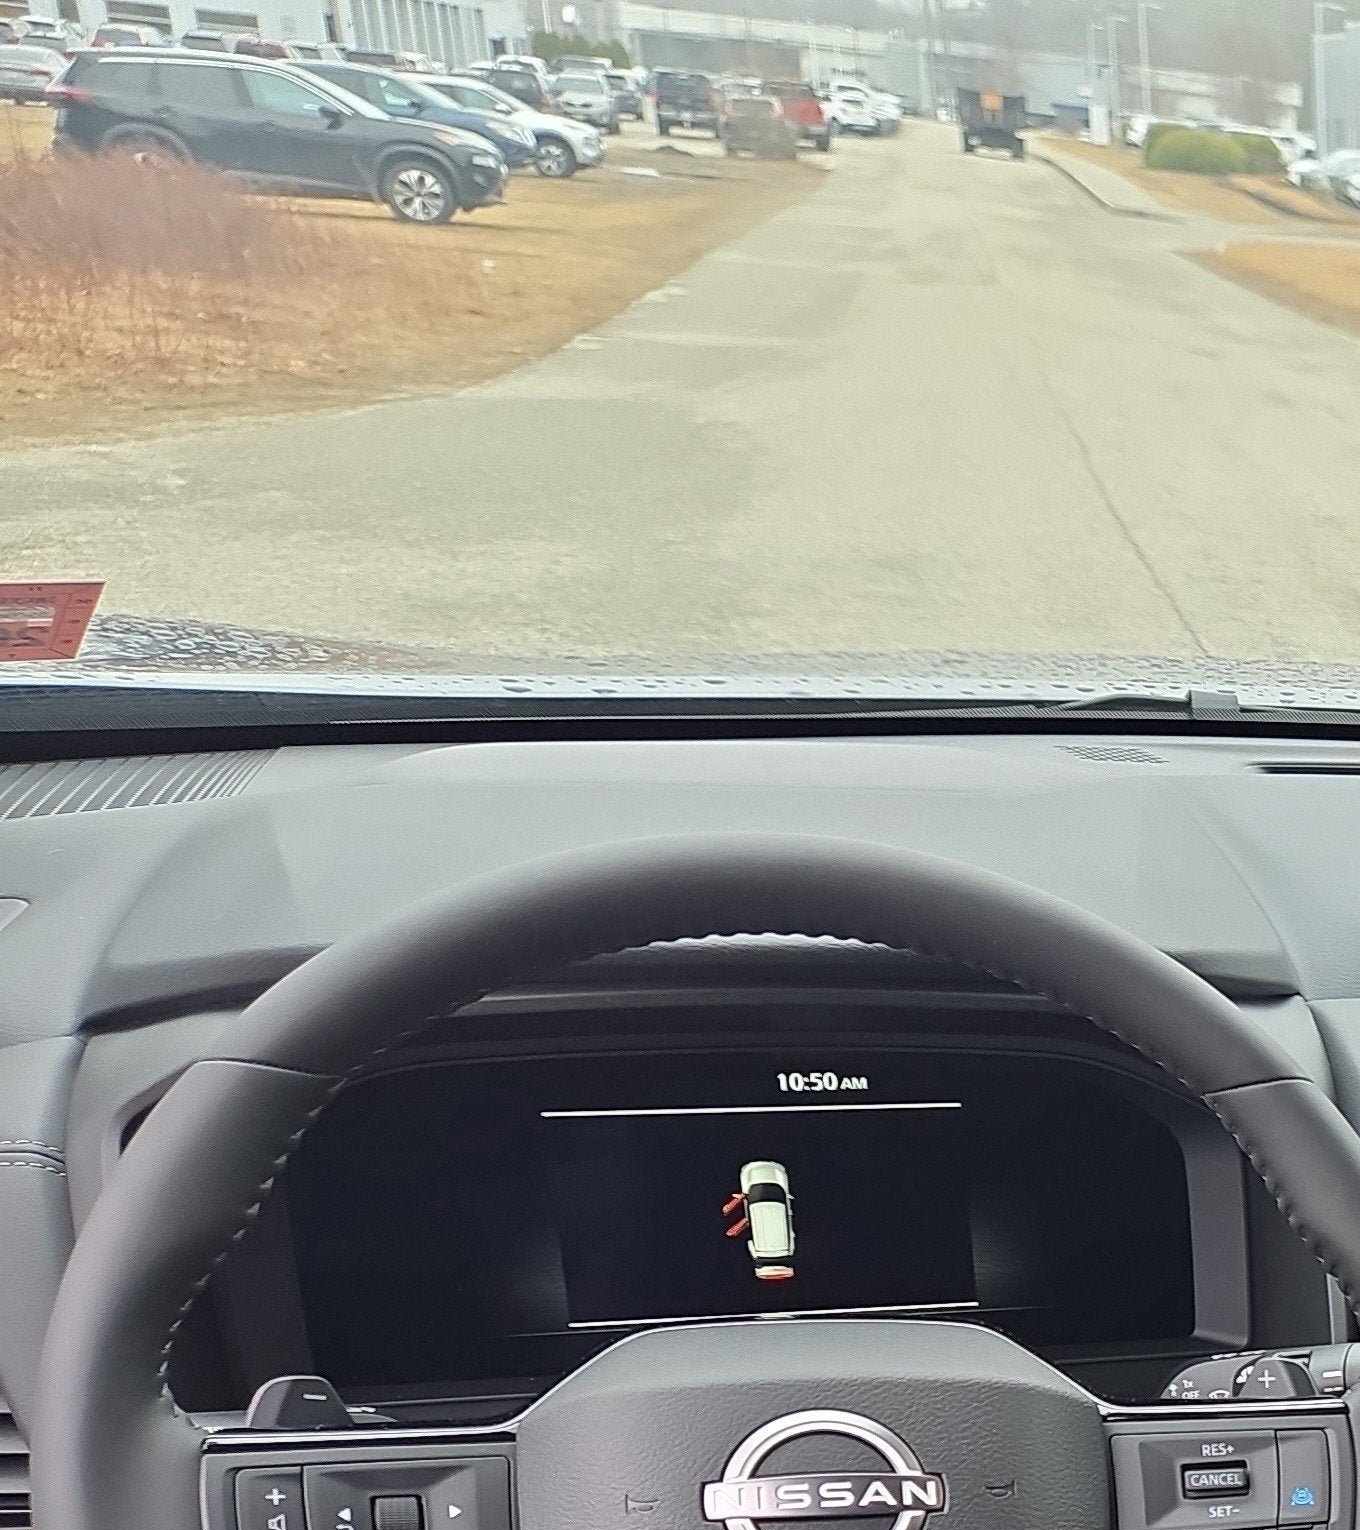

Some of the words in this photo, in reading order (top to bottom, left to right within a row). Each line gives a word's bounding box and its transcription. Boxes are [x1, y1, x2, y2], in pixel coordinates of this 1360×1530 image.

[776, 1072, 839, 1092] 10:50
[840, 1076, 868, 1091] AM
[1201, 1443, 1235, 1456] RES+
[1189, 1473, 1242, 1487] CANCEL
[712, 1481, 938, 1512] NISSAN
